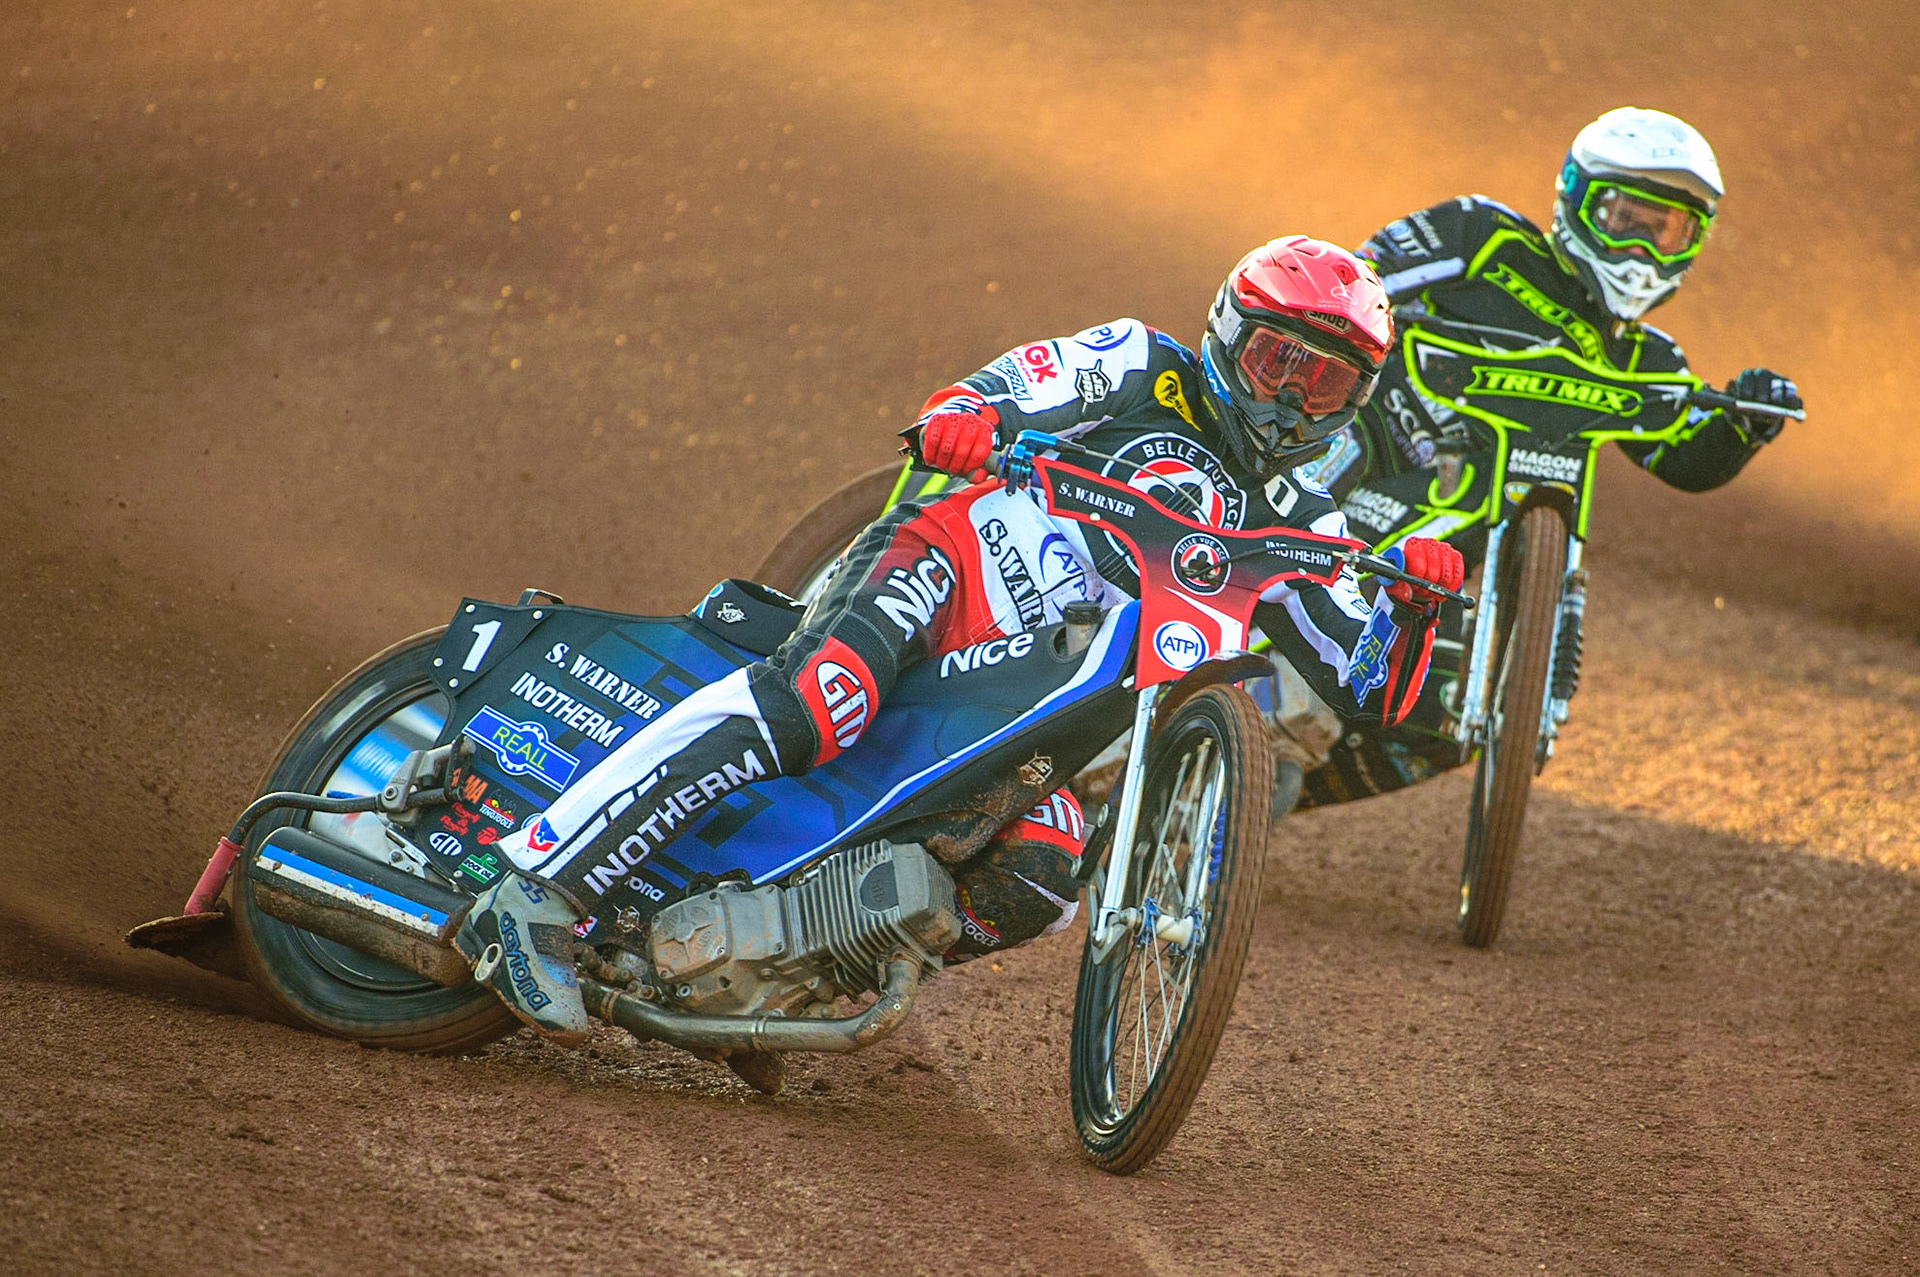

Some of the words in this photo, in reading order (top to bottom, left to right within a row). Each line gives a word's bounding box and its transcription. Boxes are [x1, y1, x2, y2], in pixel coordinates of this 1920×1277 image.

[1022, 341, 1058, 384] GK
[1058, 482, 1072, 498] S.
[1075, 487, 1136, 518] WARNER
[1141, 440, 1195, 463] BELLE
[1204, 457, 1230, 493] VUE
[1223, 496, 1240, 531] ACE
[979, 518, 1008, 556] S.
[462, 619, 502, 673] 1
[1162, 636, 1199, 657] ATPI
[545, 642, 570, 669] S.
[569, 653, 661, 720] WARNER
[510, 672, 624, 748] INOTHERM
[492, 725, 548, 772] REALL
[583, 748, 767, 896] INOTHERM
[463, 859, 481, 873] ROCK
[500, 911, 552, 1012] daytona
